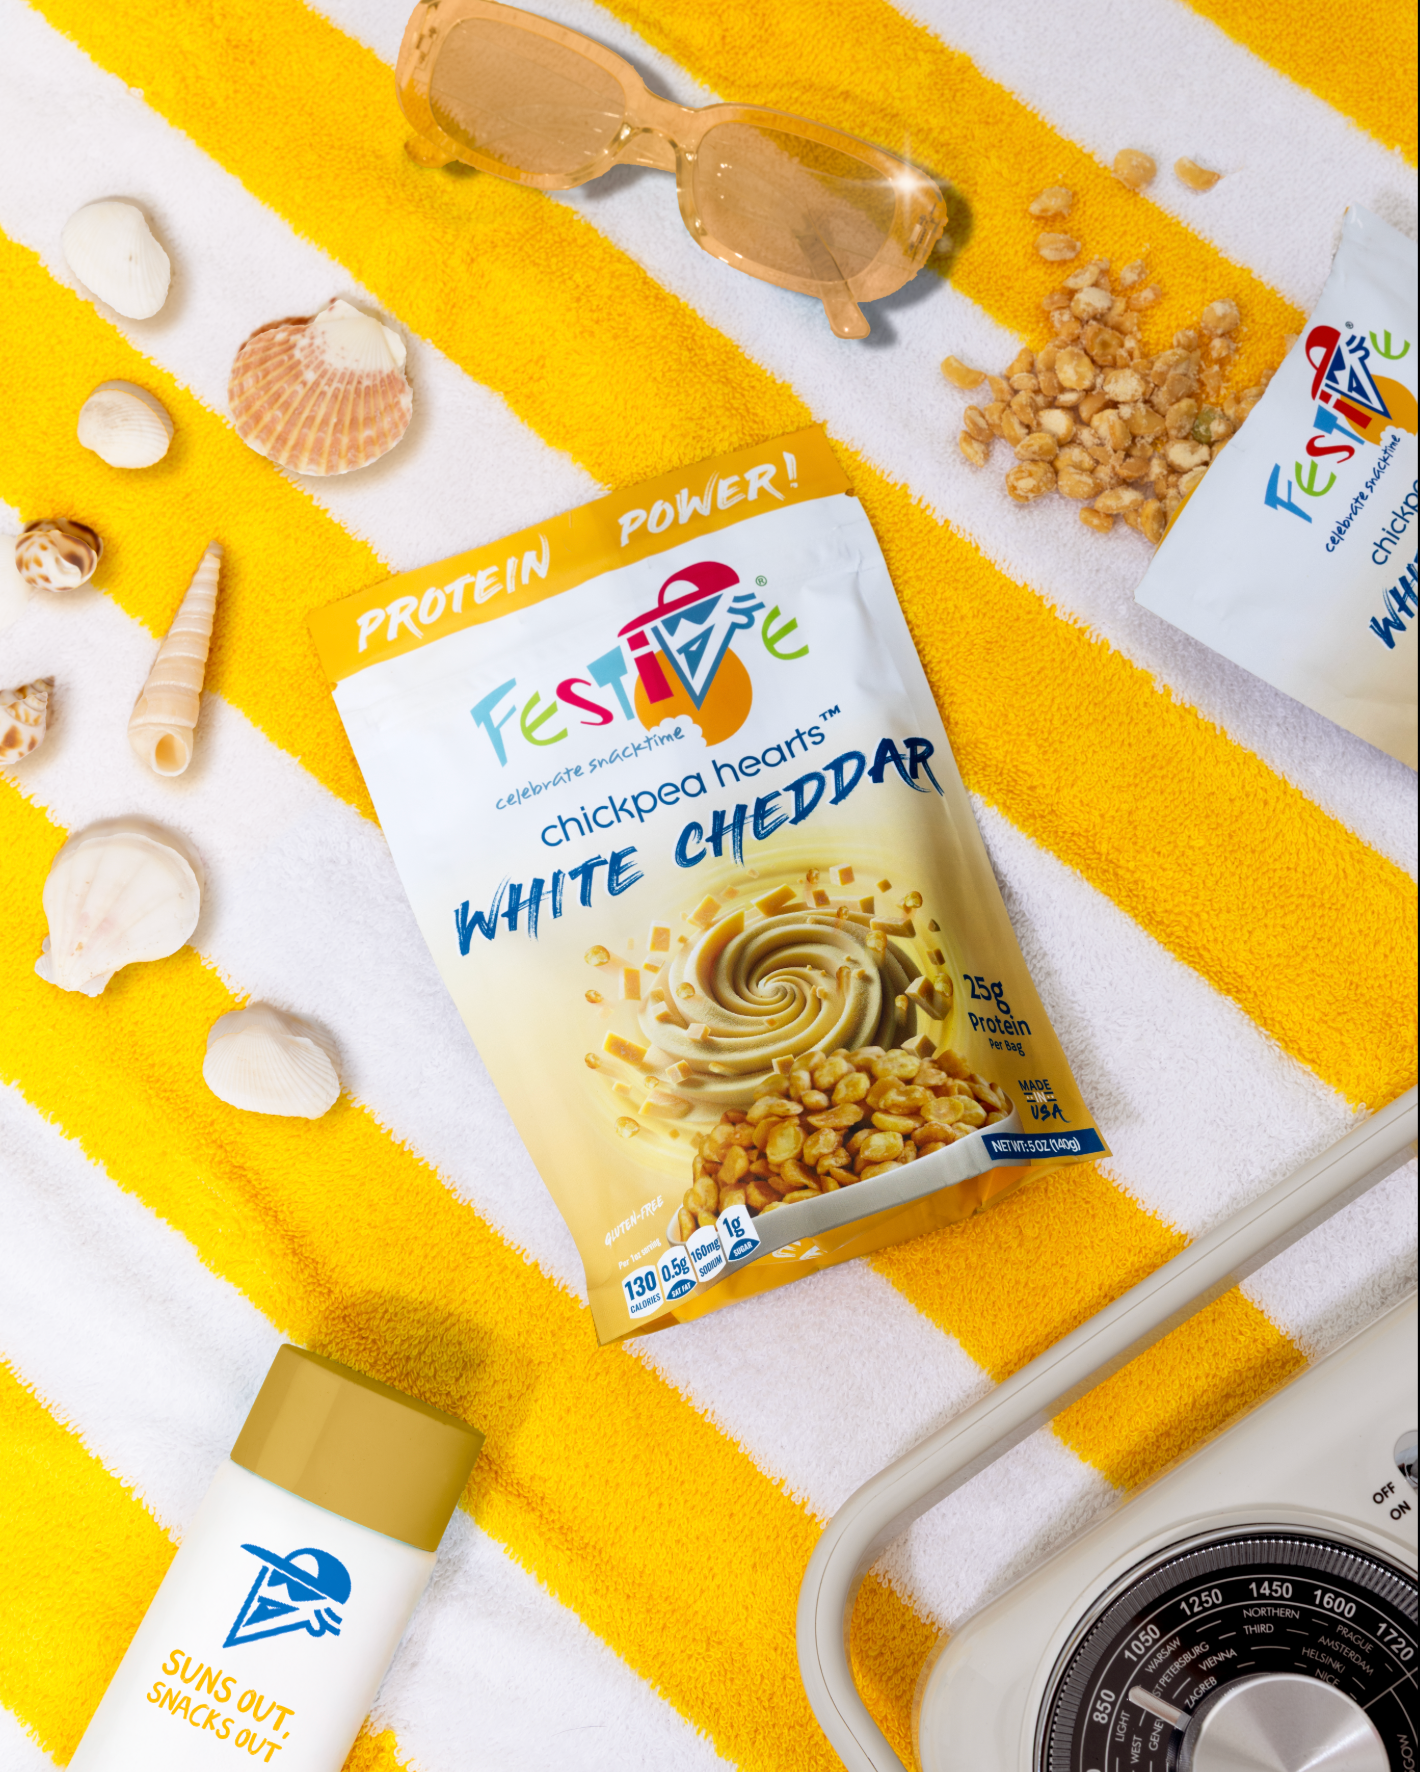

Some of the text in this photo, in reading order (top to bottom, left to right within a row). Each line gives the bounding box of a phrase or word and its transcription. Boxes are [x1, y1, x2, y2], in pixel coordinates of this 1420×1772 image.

[1325, 434, 1401, 553] celebrate snacktime
[356, 452, 798, 653] PROTEIN POWER!
[1369, 548, 1418, 650] WH
[495, 725, 686, 811] celebrate snacktime
[541, 773, 708, 847] chickpea
[453, 737, 945, 955] WHITE CHEDDAR
[963, 974, 1011, 1015] 25g
[968, 1012, 1032, 1036] Protein
[989, 1038, 1025, 1057] Per Bag
[1018, 1079, 1051, 1091] MADE
[1033, 1092, 1047, 1103] IN
[1030, 1103, 1072, 1123] USA
[1049, 1136, 1081, 1152] (140g)
[604, 1195, 664, 1248] GLUTEN-FREE
[722, 1215, 745, 1238] 1g
[618, 1259, 630, 1270] Per
[641, 1238, 662, 1256] serving
[690, 1237, 721, 1263] 160mg
[733, 1241, 753, 1257] SUGAR
[661, 1255, 690, 1283] 0.5g
[699, 1254, 723, 1278] SODIUM
[624, 1270, 657, 1301] 130
[671, 1281, 692, 1298] SAT FAT
[630, 1293, 661, 1314] CALORIES
[1372, 1481, 1397, 1505] OFF
[1389, 1500, 1412, 1521] ON
[1180, 1588, 1222, 1616] 1250
[1249, 1581, 1293, 1598] 1450
[1313, 1589, 1357, 1618] 1600
[1243, 1607, 1300, 1619] NORTHERN
[1124, 1624, 1161, 1661] 1050
[1243, 1624, 1274, 1635] THIRD
[1336, 1624, 1374, 1654] PRAGUE
[1376, 1622, 1414, 1661] 1720
[1145, 1637, 1181, 1674] WARSAW
[1160, 1641, 1210, 1687] PETERSBURG
[1198, 1648, 1238, 1672] VIENNA
[1302, 1646, 1346, 1673] HELSINKI
[1318, 1635, 1374, 1676] AMSTERDAM
[1315, 1668, 1340, 1686] NICE
[162, 1649, 295, 1740] SUNS OUT,
[1093, 1689, 1116, 1724] 850
[1184, 1676, 1218, 1709] ZAGREB
[146, 1680, 282, 1764] SNACKS OUT
[1115, 1710, 1130, 1742] LIGHT
[1130, 1734, 1142, 1764] WEST
